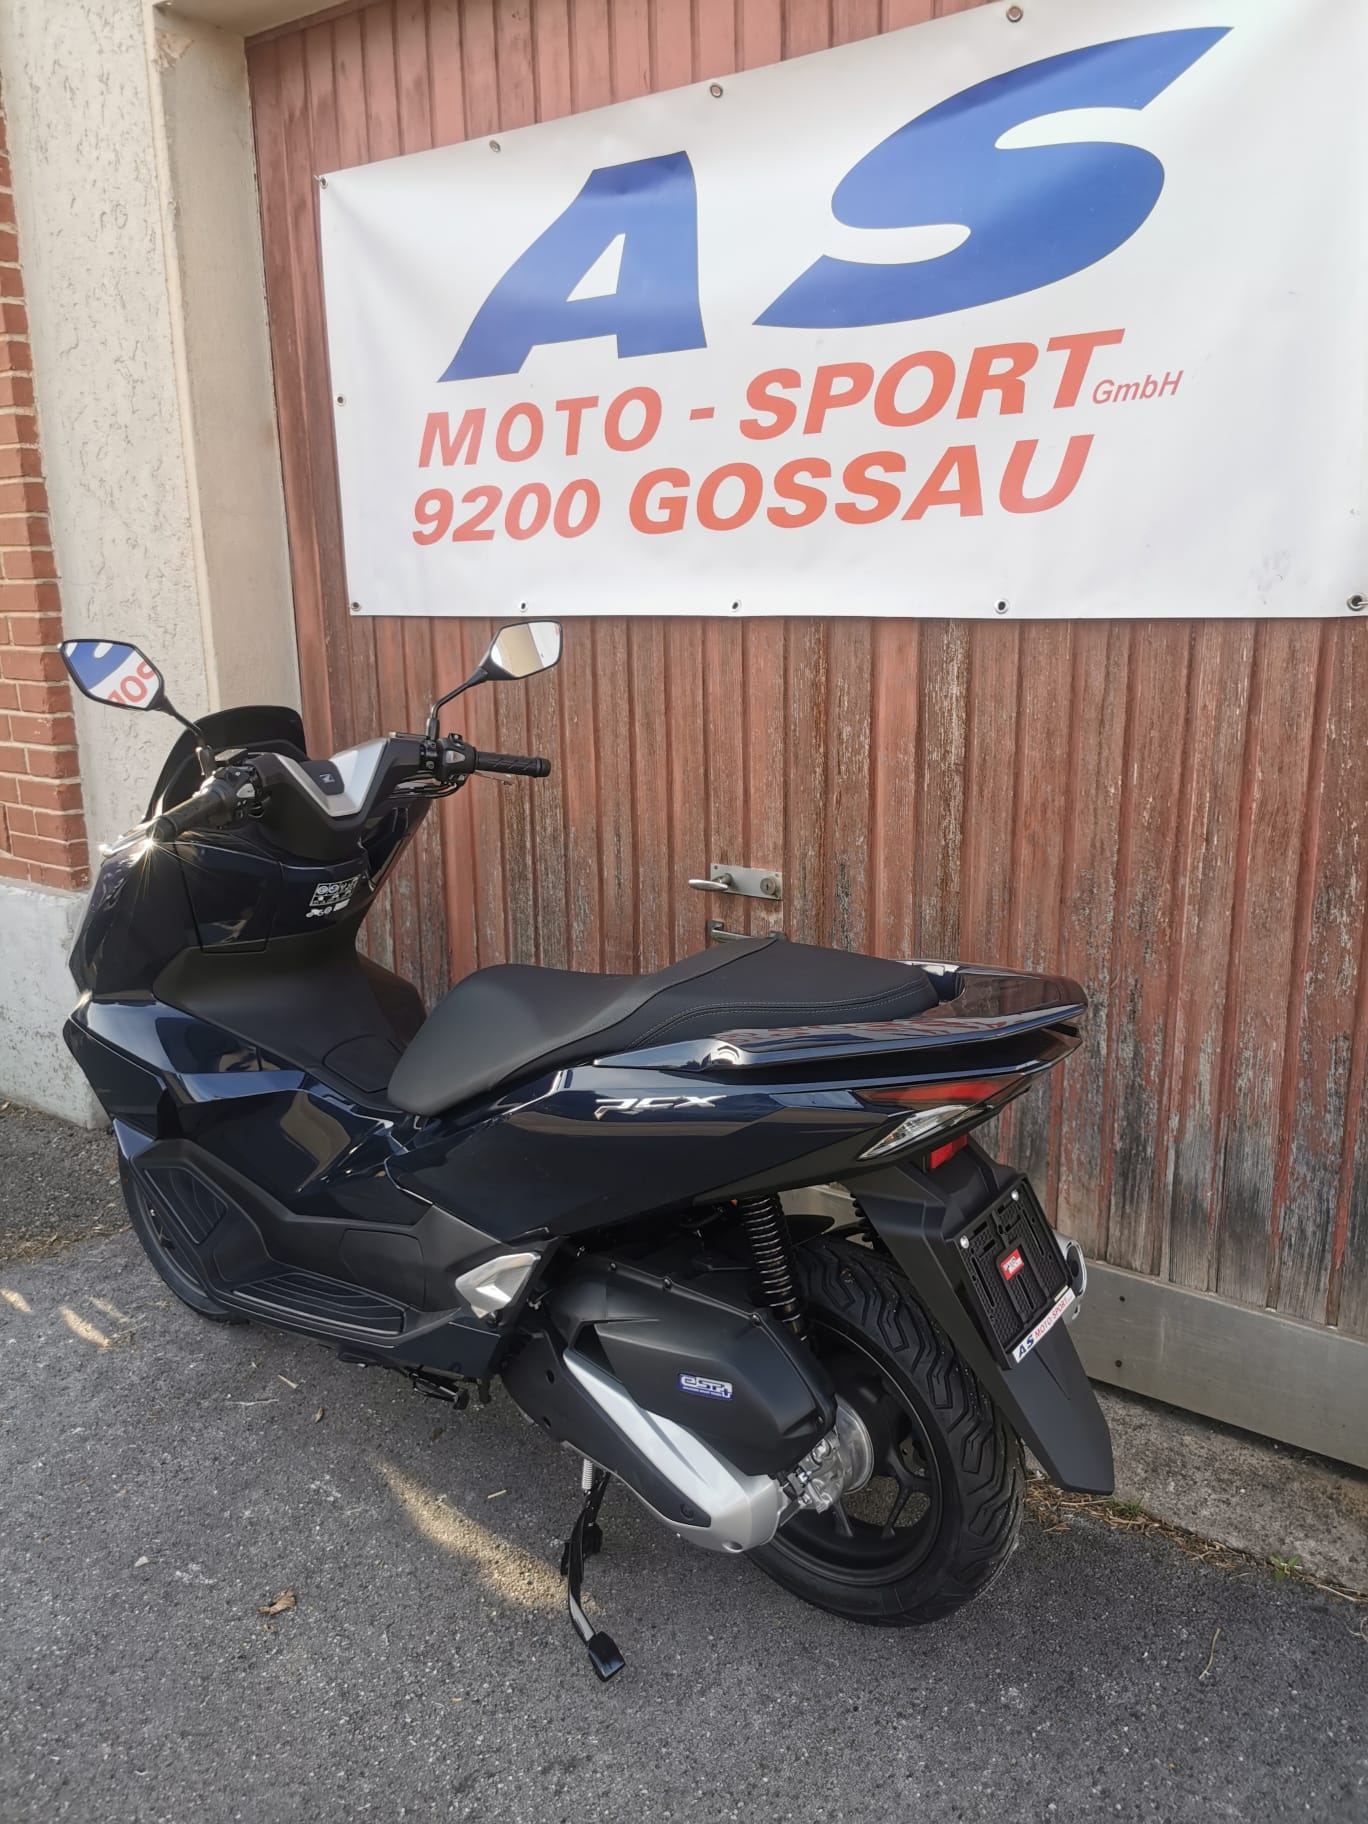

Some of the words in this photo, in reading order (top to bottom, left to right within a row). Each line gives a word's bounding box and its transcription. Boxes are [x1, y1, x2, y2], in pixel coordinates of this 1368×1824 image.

[438, 26, 1232, 382] AS
[419, 387, 663, 469] MOTO
[739, 328, 1125, 441] SPORT
[1092, 370, 1184, 405] GmbH
[411, 478, 602, 547] 9200
[628, 434, 1095, 536] GOSSAU
